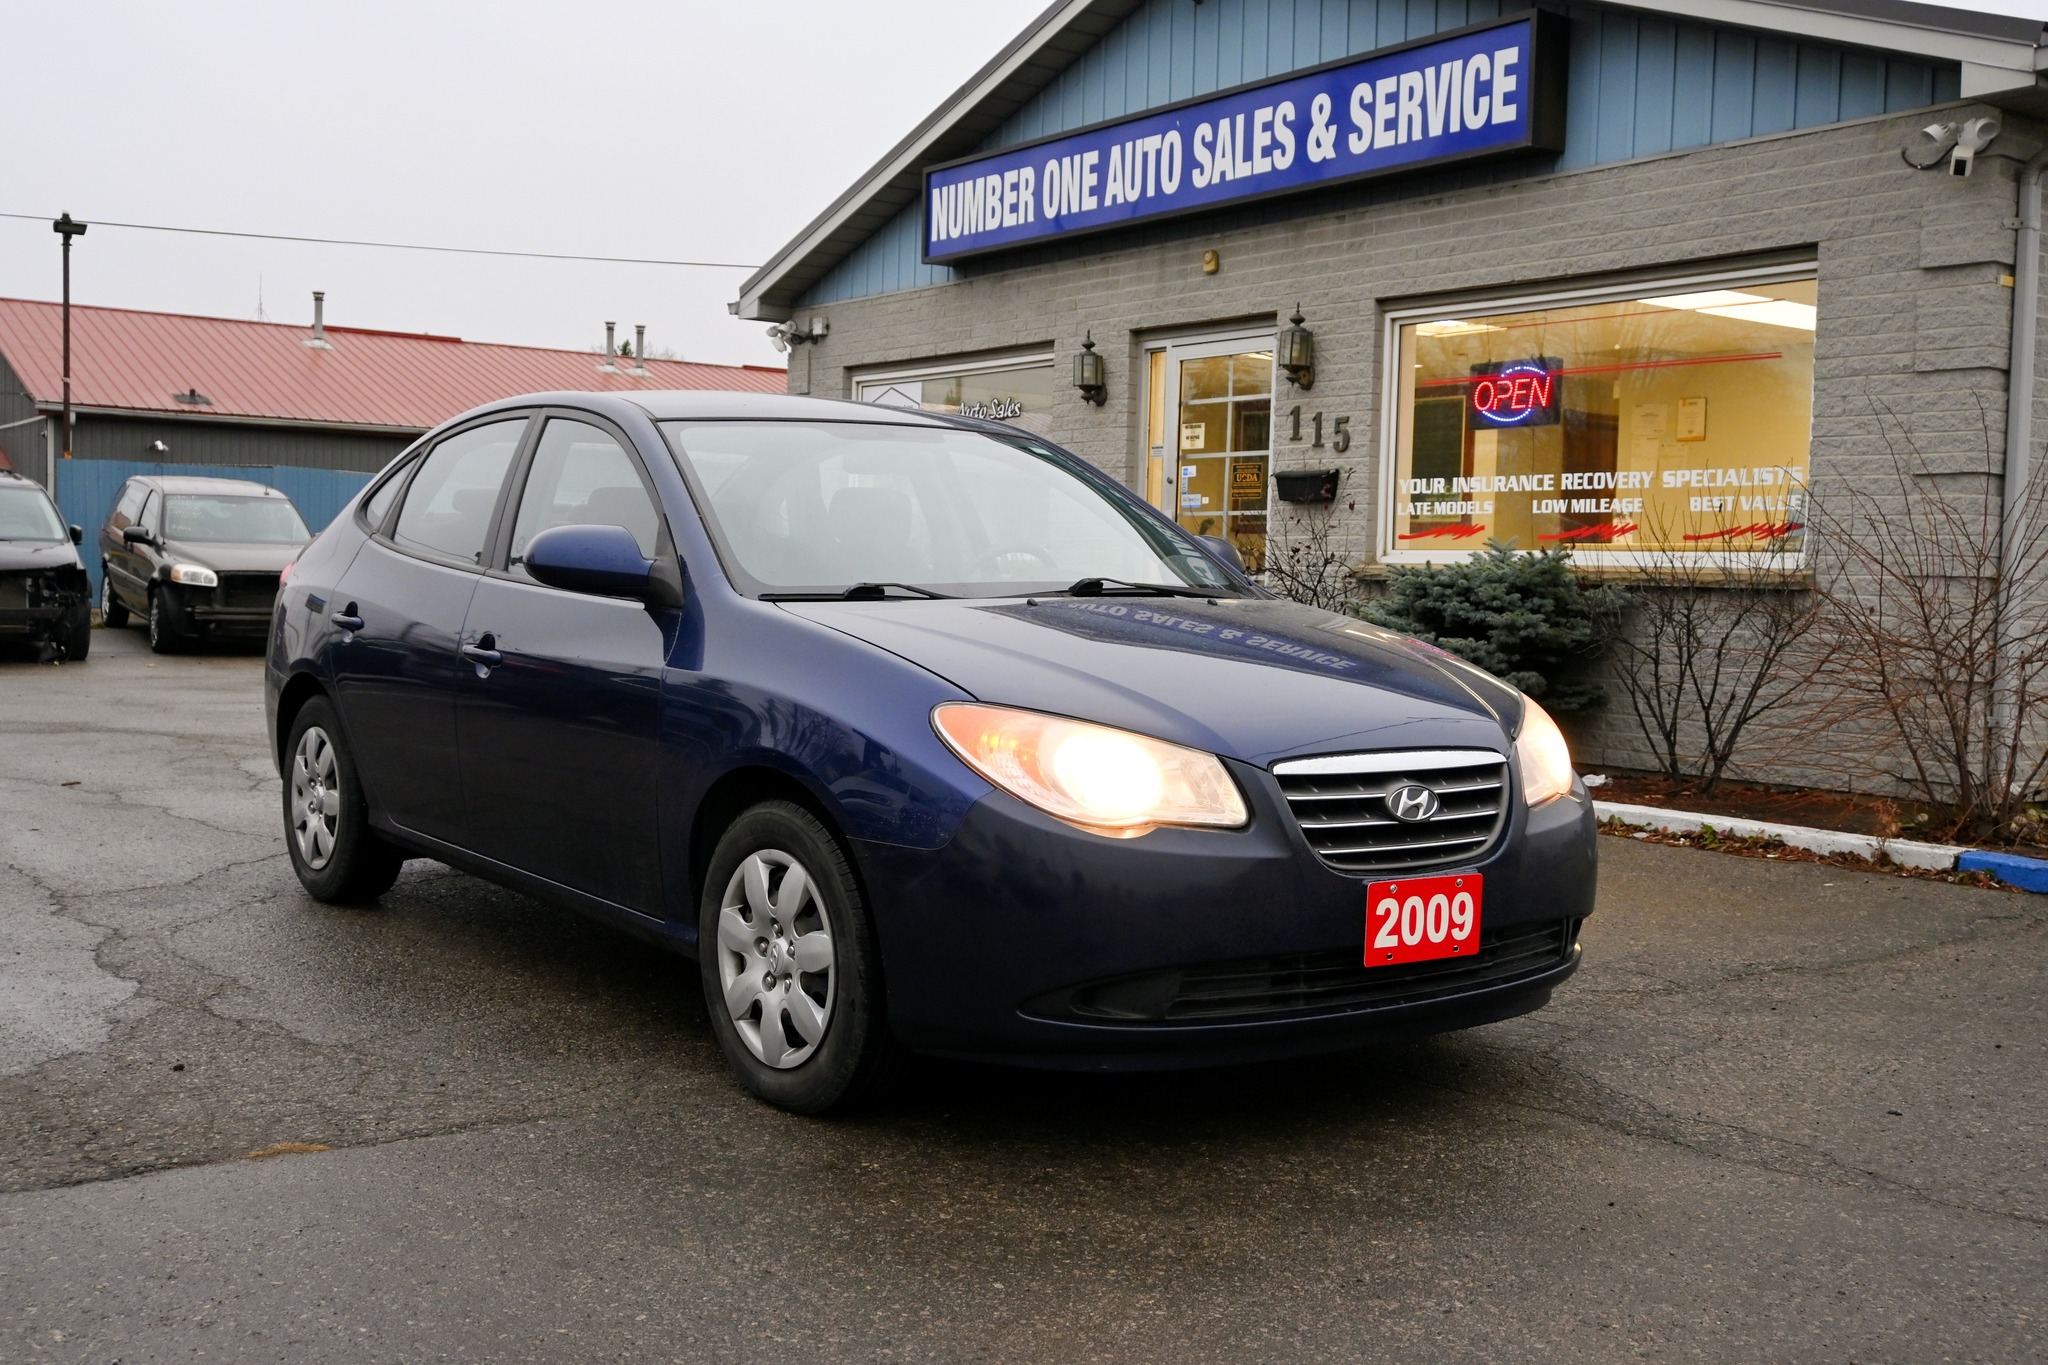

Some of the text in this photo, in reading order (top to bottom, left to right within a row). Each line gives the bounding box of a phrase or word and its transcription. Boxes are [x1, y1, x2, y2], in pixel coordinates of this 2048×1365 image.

[931, 46, 1520, 241] NUMBER ONE AUTO SALES & SERVICE
[958, 396, 1022, 420] Auto Sales
[1474, 376, 1551, 411] OPEN
[1289, 405, 1351, 453] 115
[1399, 477, 1446, 495] YOUR
[1452, 474, 1555, 493] INSURANCE
[1560, 471, 1654, 491] RECOVERY
[1662, 466, 1804, 488] SPECIALISTS
[1397, 500, 1494, 516] LATE MODELS
[1532, 497, 1643, 514] LOW MILEAGE
[1689, 495, 1735, 512] BEST
[1373, 892, 1474, 949] 2009
